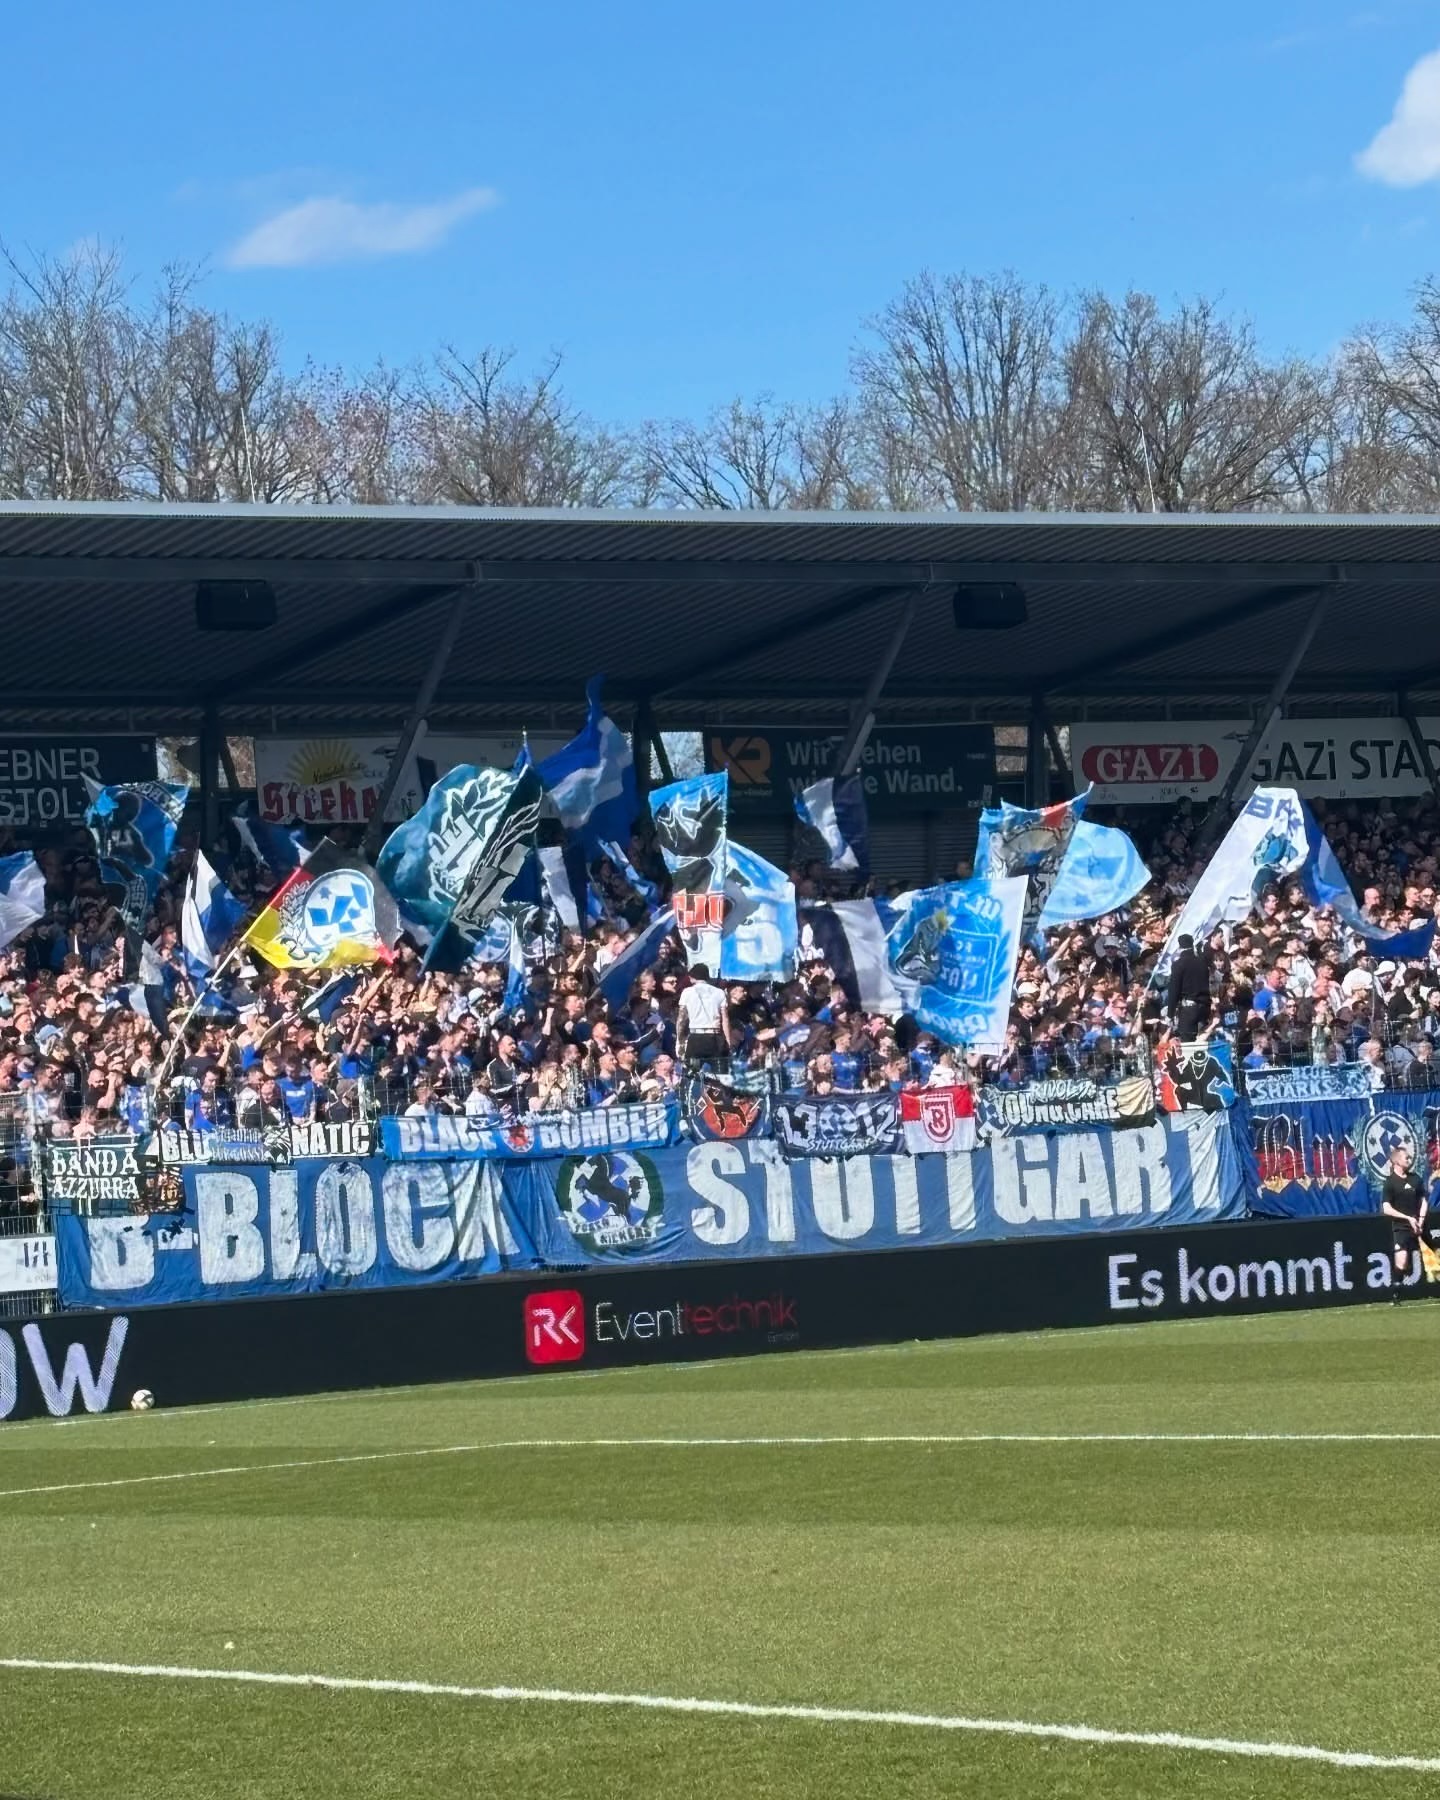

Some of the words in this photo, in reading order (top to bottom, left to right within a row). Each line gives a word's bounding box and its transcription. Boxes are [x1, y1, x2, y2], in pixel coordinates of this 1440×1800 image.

[857, 739, 921, 766] ehen
[1096, 747, 1210, 783] GAZI
[885, 767, 964, 794] Wand.
[0, 787, 87, 820] STOL
[291, 1121, 371, 1157] NATIC
[540, 1102, 670, 1149] BOMBER
[51, 1148, 142, 1177] BANDA
[51, 1175, 141, 1200] AZZURRA
[87, 1160, 521, 1291] B-BLOCK
[686, 1112, 1230, 1245] STUTTGART
[1107, 1252, 1166, 1310] Es
[1178, 1240, 1354, 1304] kommt
